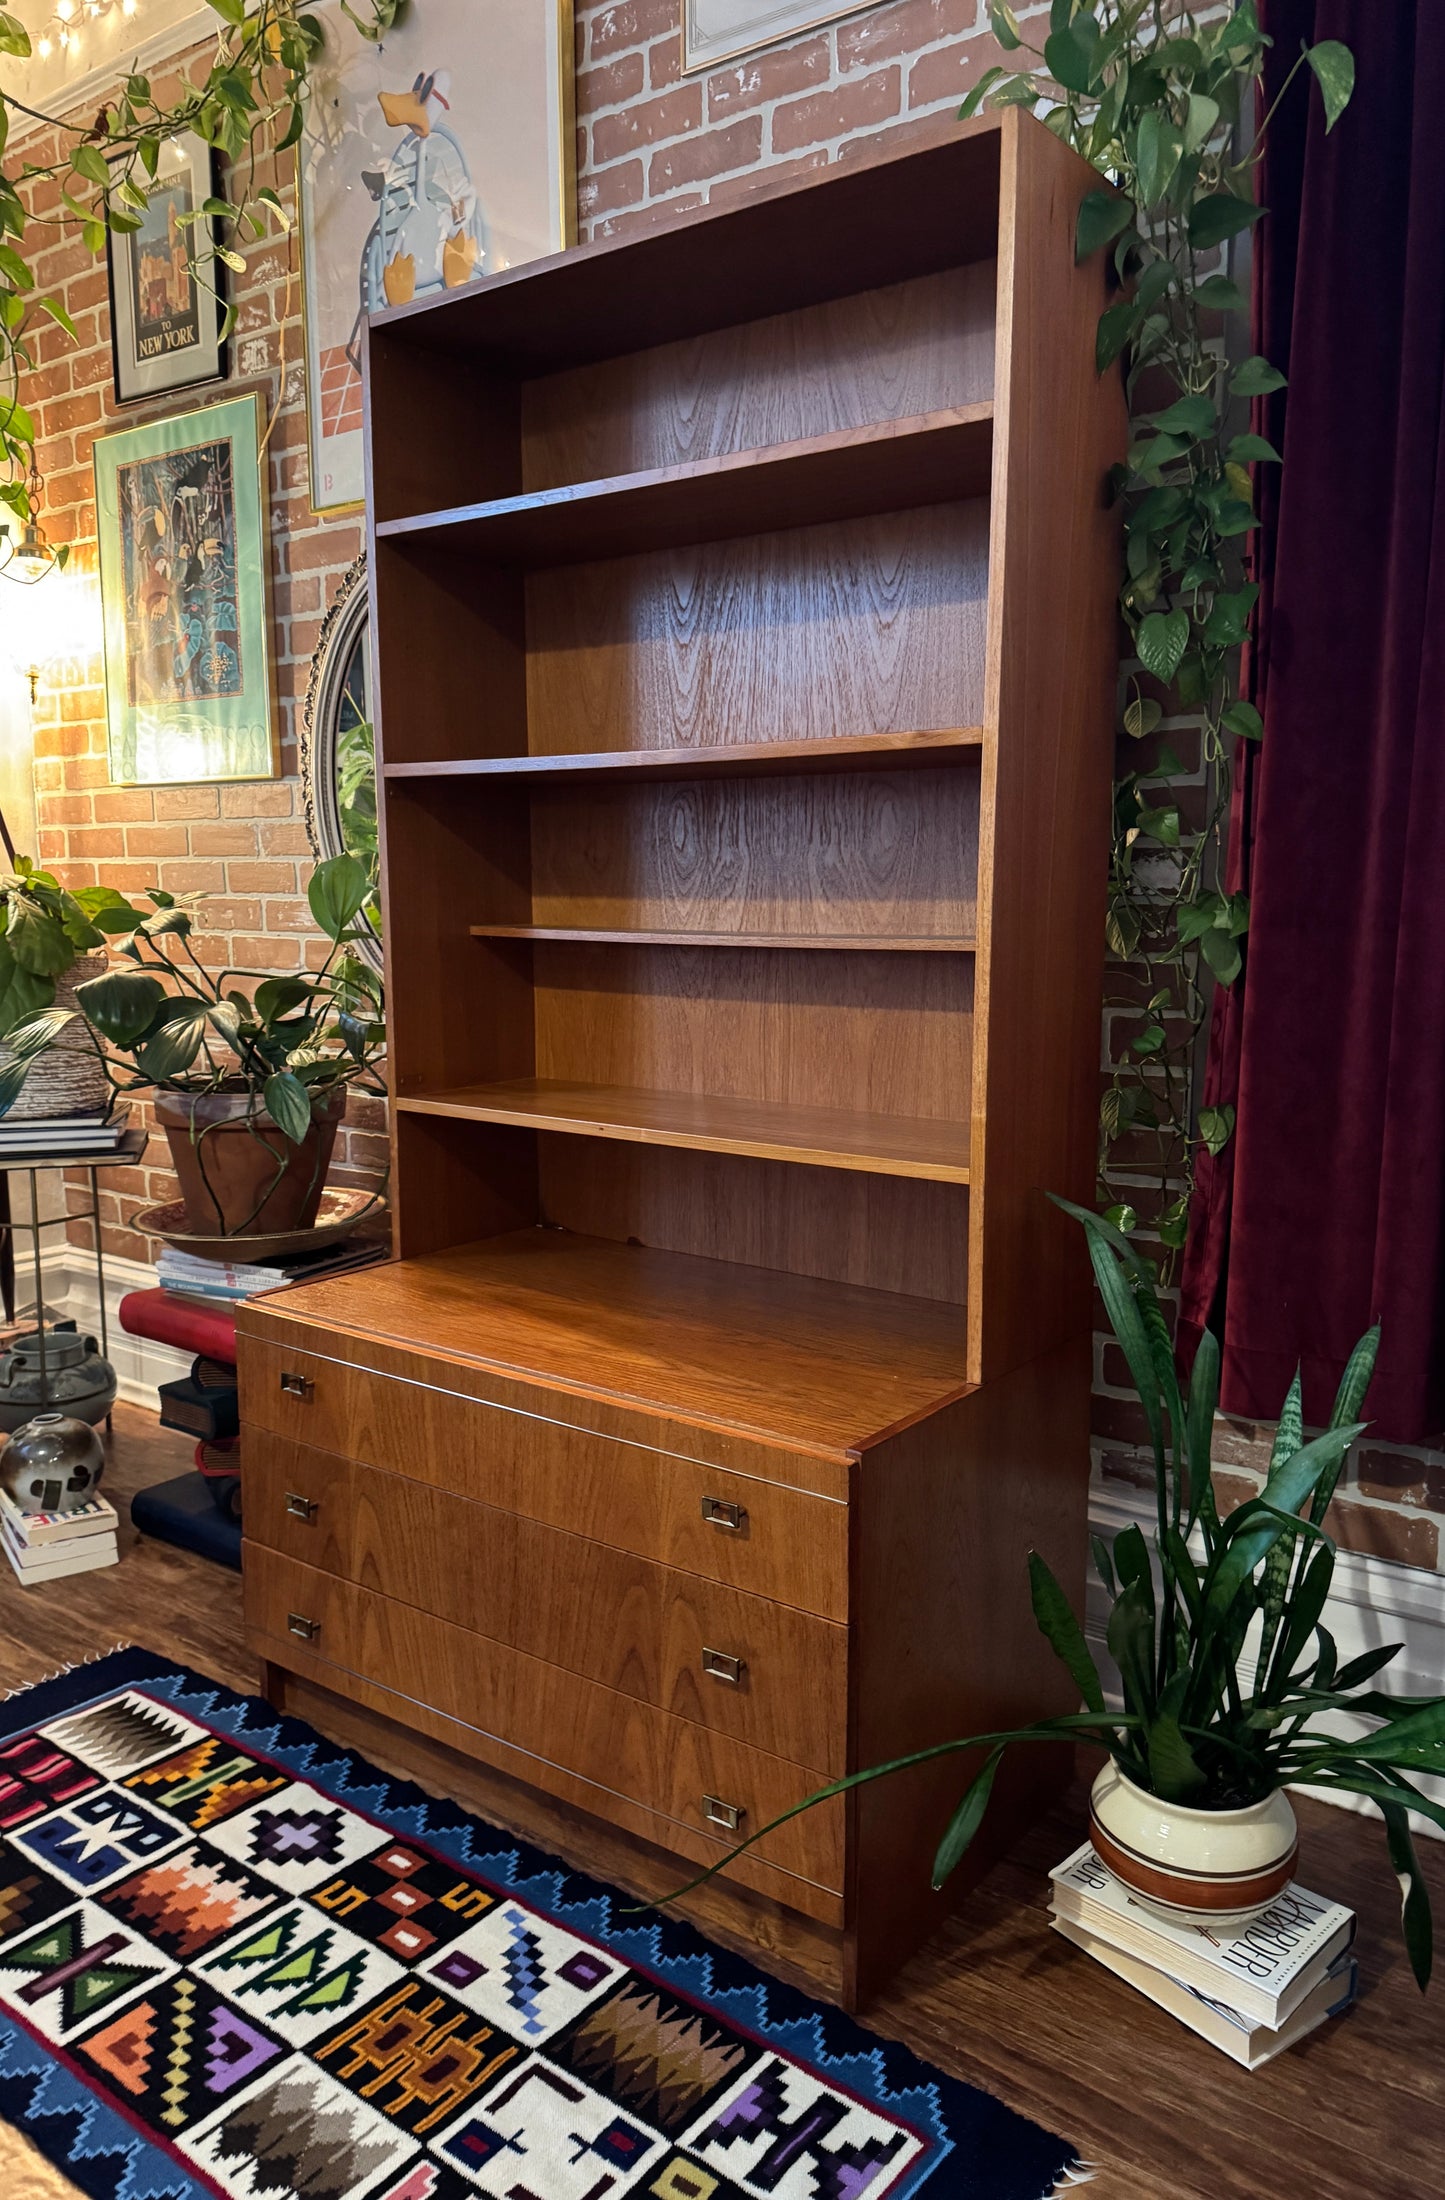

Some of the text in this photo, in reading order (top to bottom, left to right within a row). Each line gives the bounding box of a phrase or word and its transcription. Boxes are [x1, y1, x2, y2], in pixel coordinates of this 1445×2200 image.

[139, 325, 195, 357] NEW YORK
[161, 320, 172, 331] TO
[1220, 1888, 1328, 1979] MURDER
